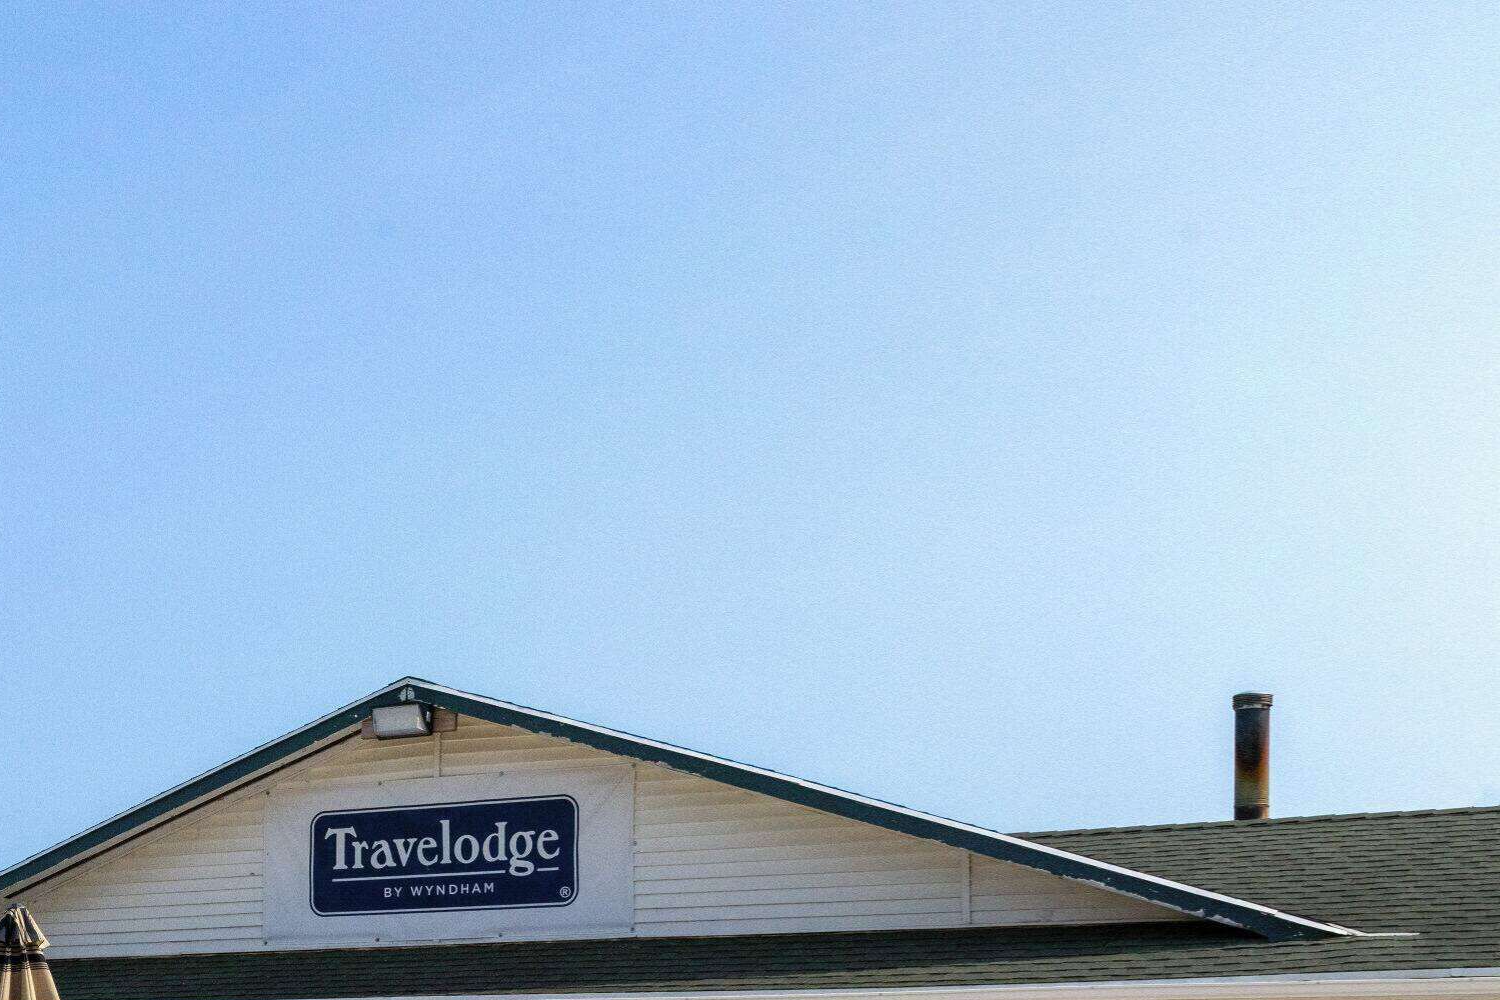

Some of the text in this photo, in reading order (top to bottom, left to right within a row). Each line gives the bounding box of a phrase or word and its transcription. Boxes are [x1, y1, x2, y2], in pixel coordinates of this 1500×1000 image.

[324, 819, 560, 876] Travelodge
[384, 882, 495, 898] BY WYNDHAM
